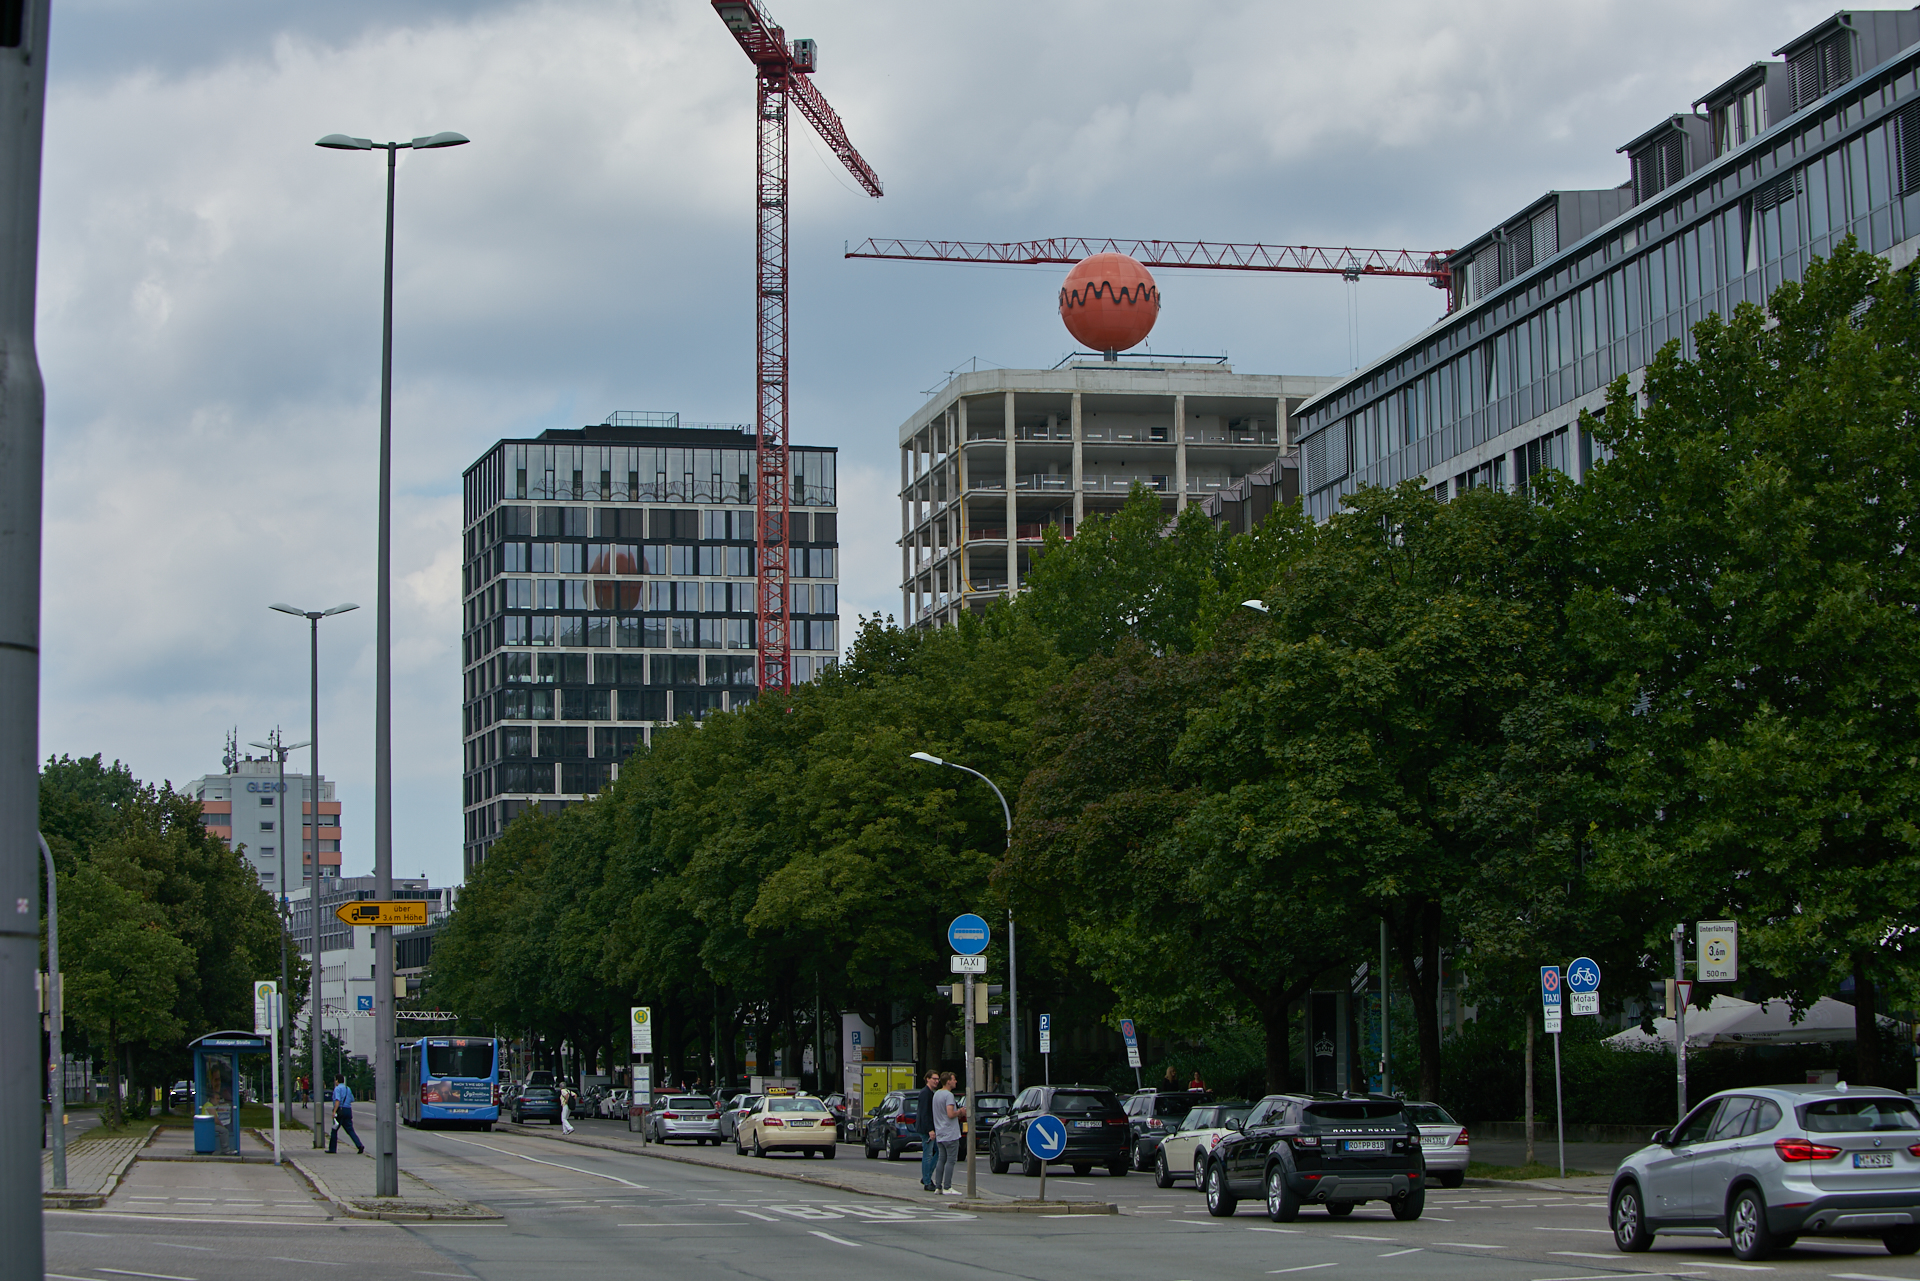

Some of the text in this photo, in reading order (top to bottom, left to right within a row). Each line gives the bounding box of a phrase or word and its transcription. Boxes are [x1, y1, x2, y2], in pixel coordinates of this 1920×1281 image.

[1699, 925, 1734, 933] Unterführung
[959, 957, 979, 966] TAXI
[1544, 993, 1560, 1002] TAXI
[1573, 995, 1596, 1003] Mofas
[762, 1204, 978, 1220] BUS
